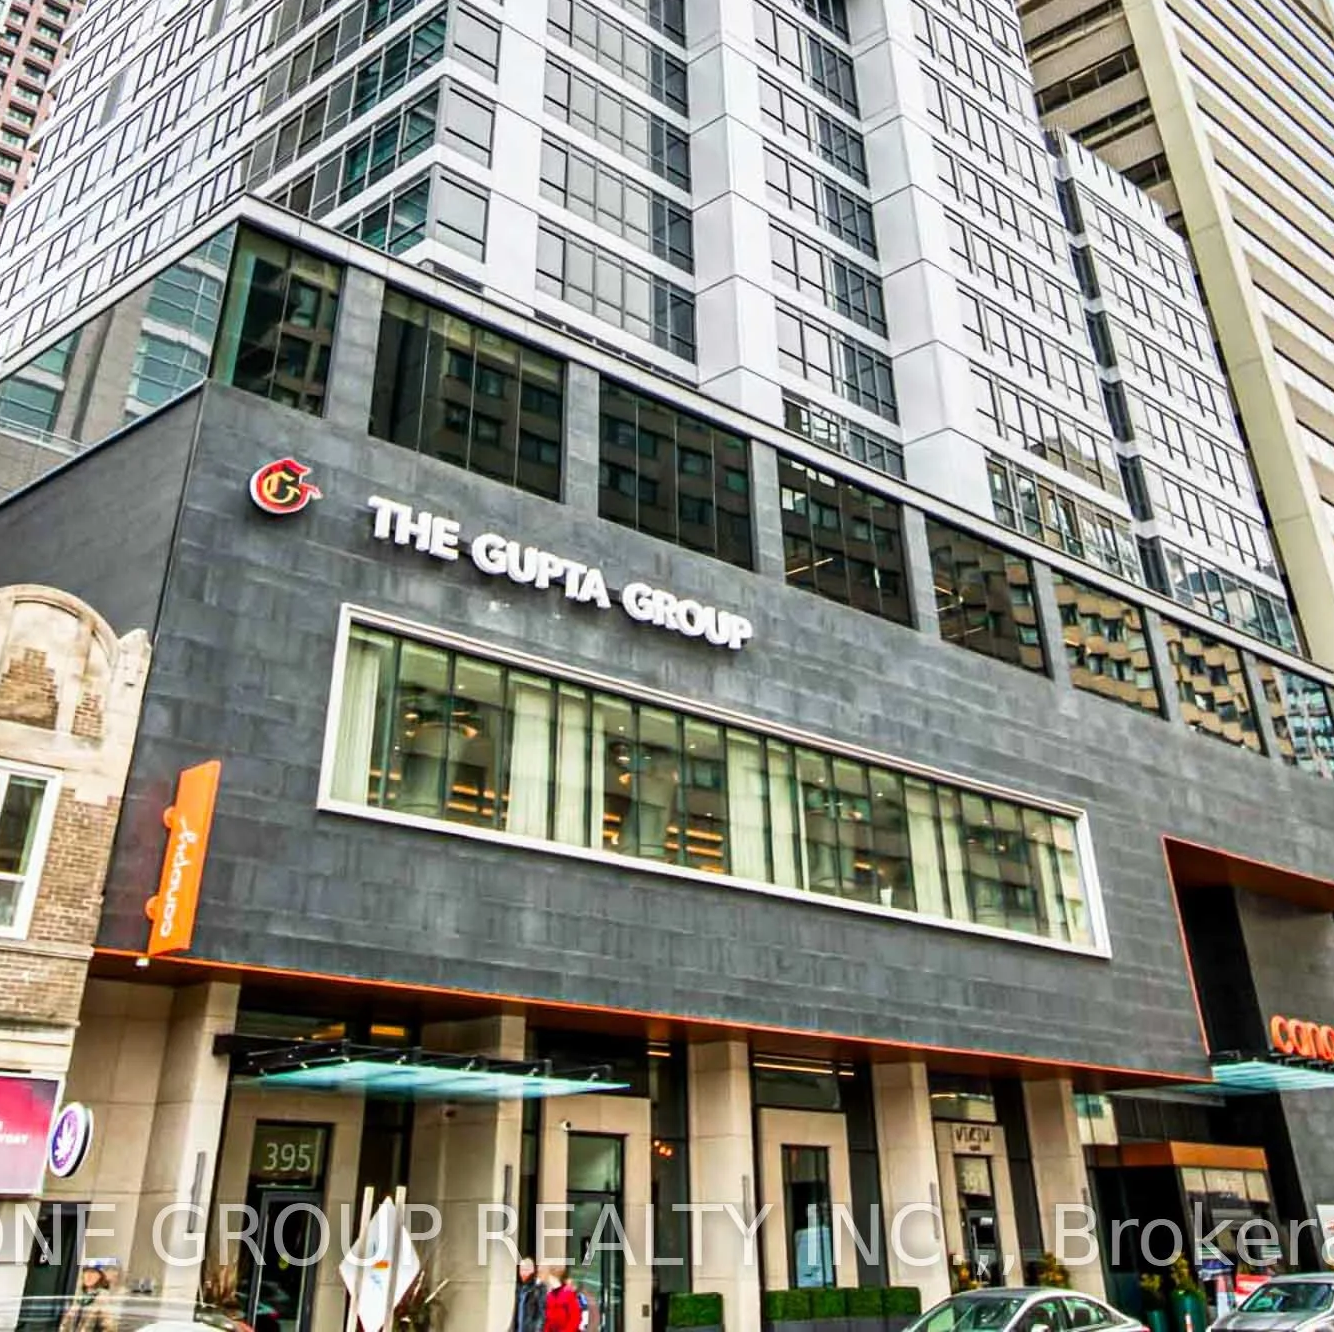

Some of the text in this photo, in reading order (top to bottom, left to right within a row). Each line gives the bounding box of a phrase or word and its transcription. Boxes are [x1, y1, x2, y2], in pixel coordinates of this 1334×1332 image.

[367, 495, 753, 650] THE GUPTA GROUP
[263, 1142, 311, 1172] 395
